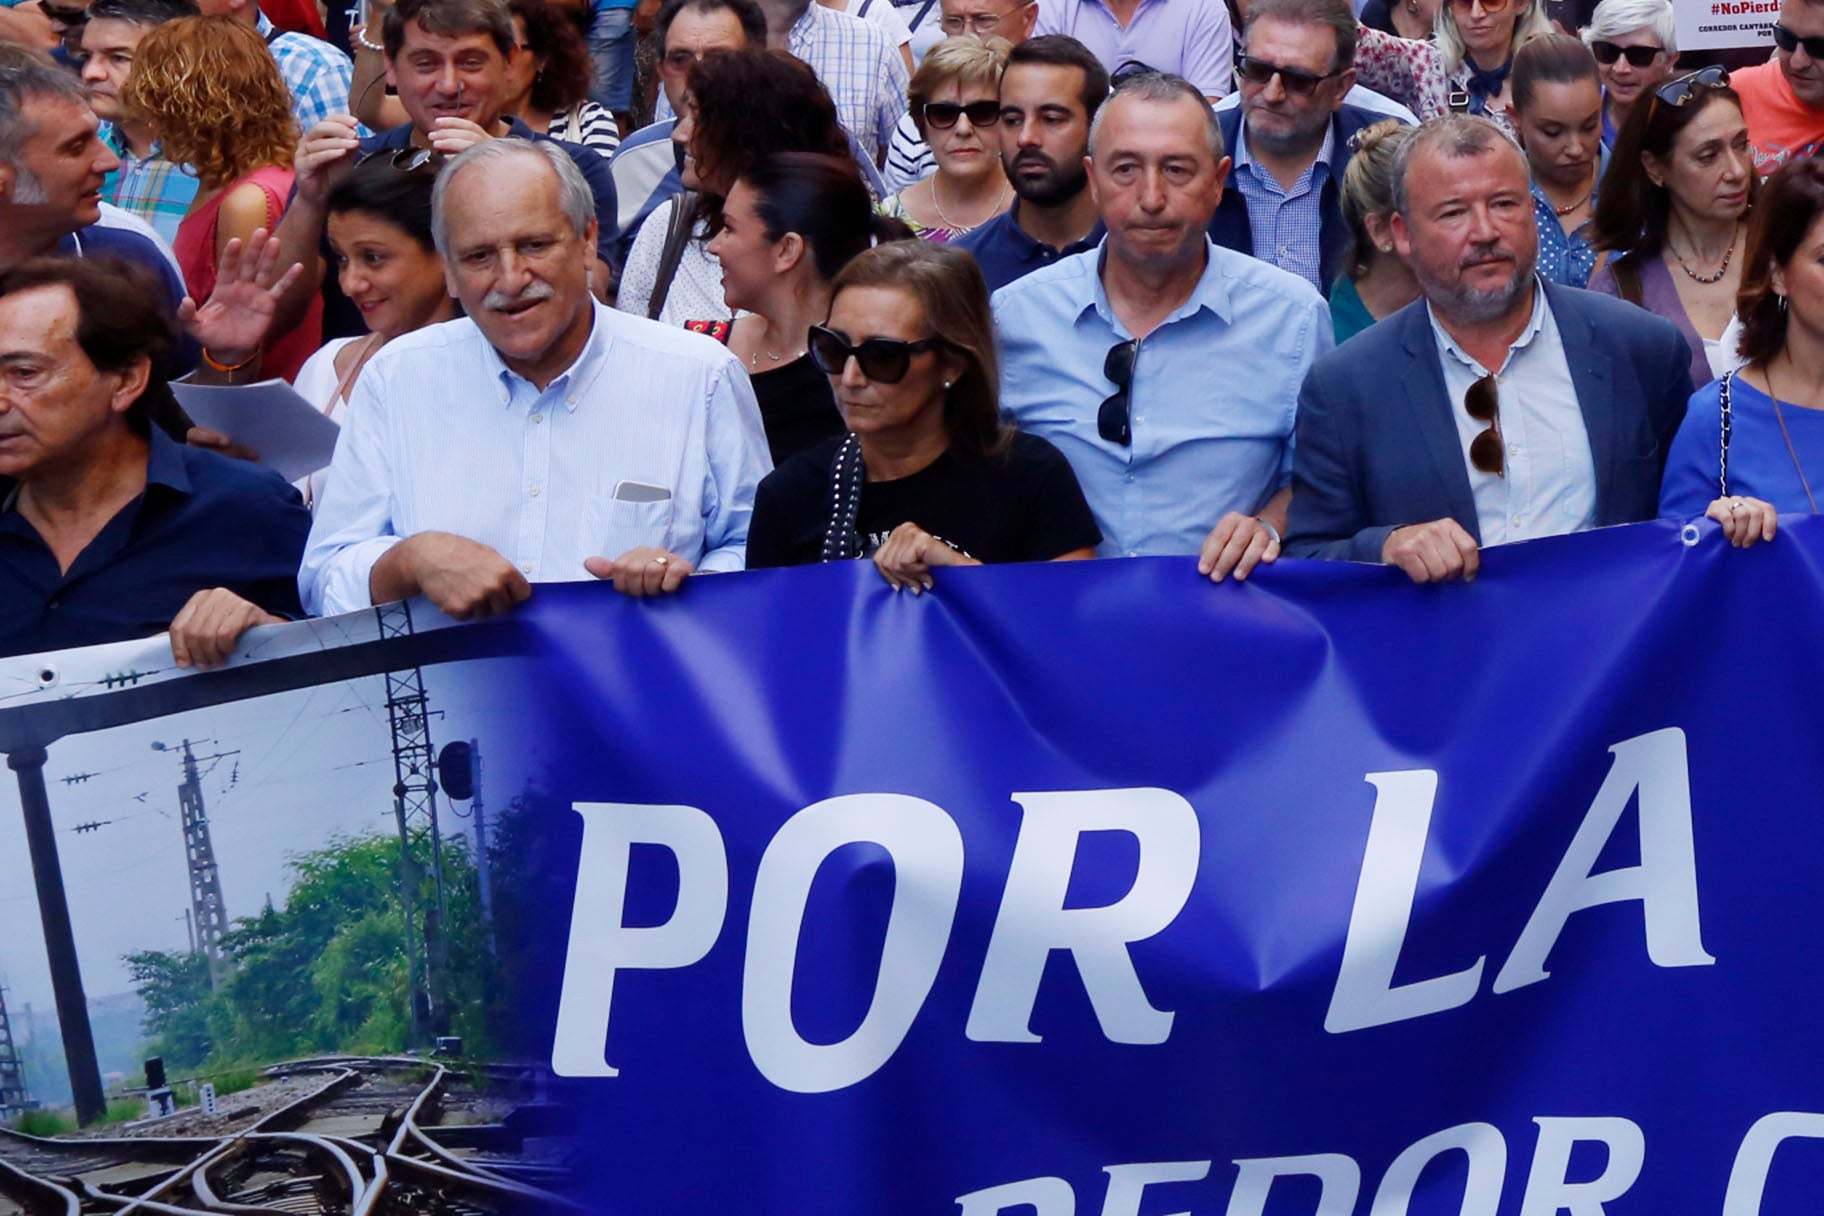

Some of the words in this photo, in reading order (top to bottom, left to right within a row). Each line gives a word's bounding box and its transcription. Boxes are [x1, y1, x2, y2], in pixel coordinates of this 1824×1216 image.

[1712, 0, 1781, 15] #NoPierd
[549, 786, 1203, 1095] POR
[1322, 725, 1716, 1034] LA
